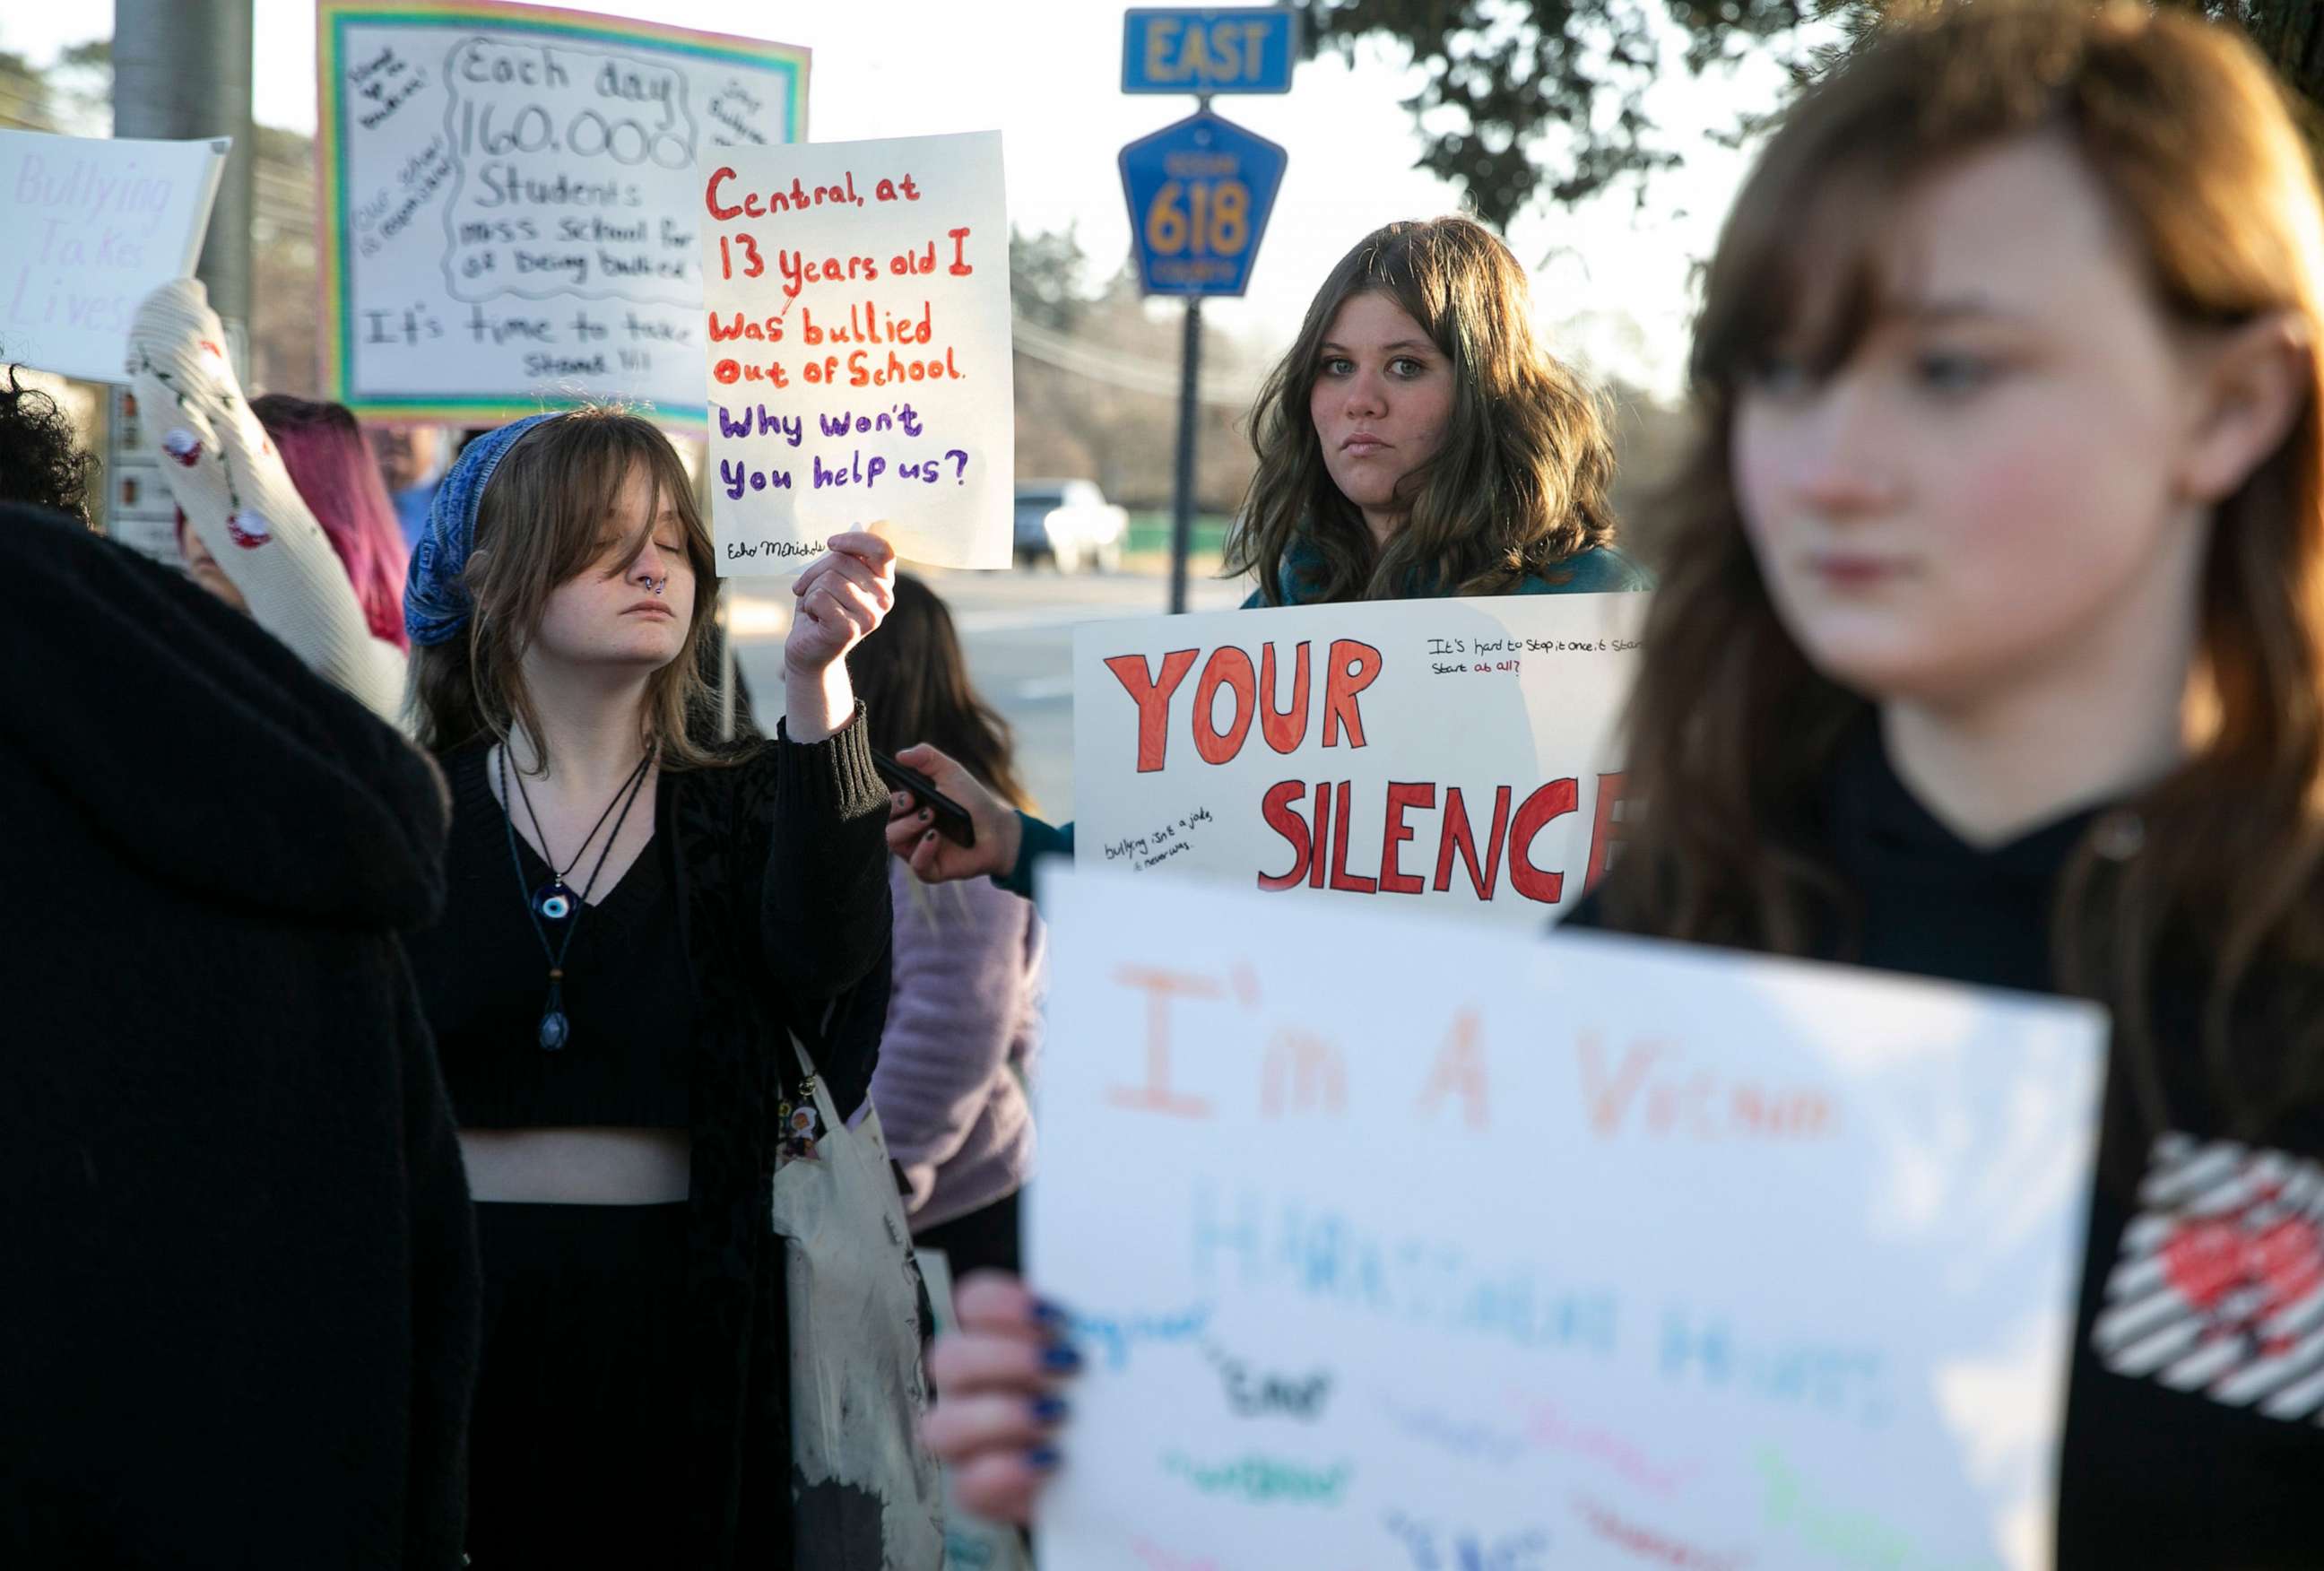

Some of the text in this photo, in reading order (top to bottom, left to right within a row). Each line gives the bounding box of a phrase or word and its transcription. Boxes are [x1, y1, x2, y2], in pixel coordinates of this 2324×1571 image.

[1145, 17, 1269, 83] EAST
[462, 40, 569, 88] Each
[594, 59, 674, 132] day
[13, 151, 175, 240] Bullying
[473, 161, 642, 208] Students
[706, 167, 921, 221] Central, at
[39, 216, 143, 268] Takes
[1145, 181, 1251, 256] 618
[720, 233, 764, 281] 13
[890, 241, 937, 275] old
[948, 228, 973, 277] I
[361, 301, 445, 345] It's
[466, 303, 559, 346] time
[569, 310, 608, 343] to
[802, 300, 932, 346] bullied
[803, 359, 840, 385] of
[718, 404, 924, 447] Why won't
[814, 450, 887, 489] help
[898, 449, 969, 486] us?
[1474, 638, 1503, 656] hard
[1507, 638, 1522, 652] to
[1474, 661, 1492, 673] at
[1496, 659, 1521, 677] all?
[1104, 638, 1383, 773] YOUR
[1104, 838, 1149, 859] bullying
[1105, 959, 1347, 1121] I'm
[1418, 1006, 1492, 1133] A
